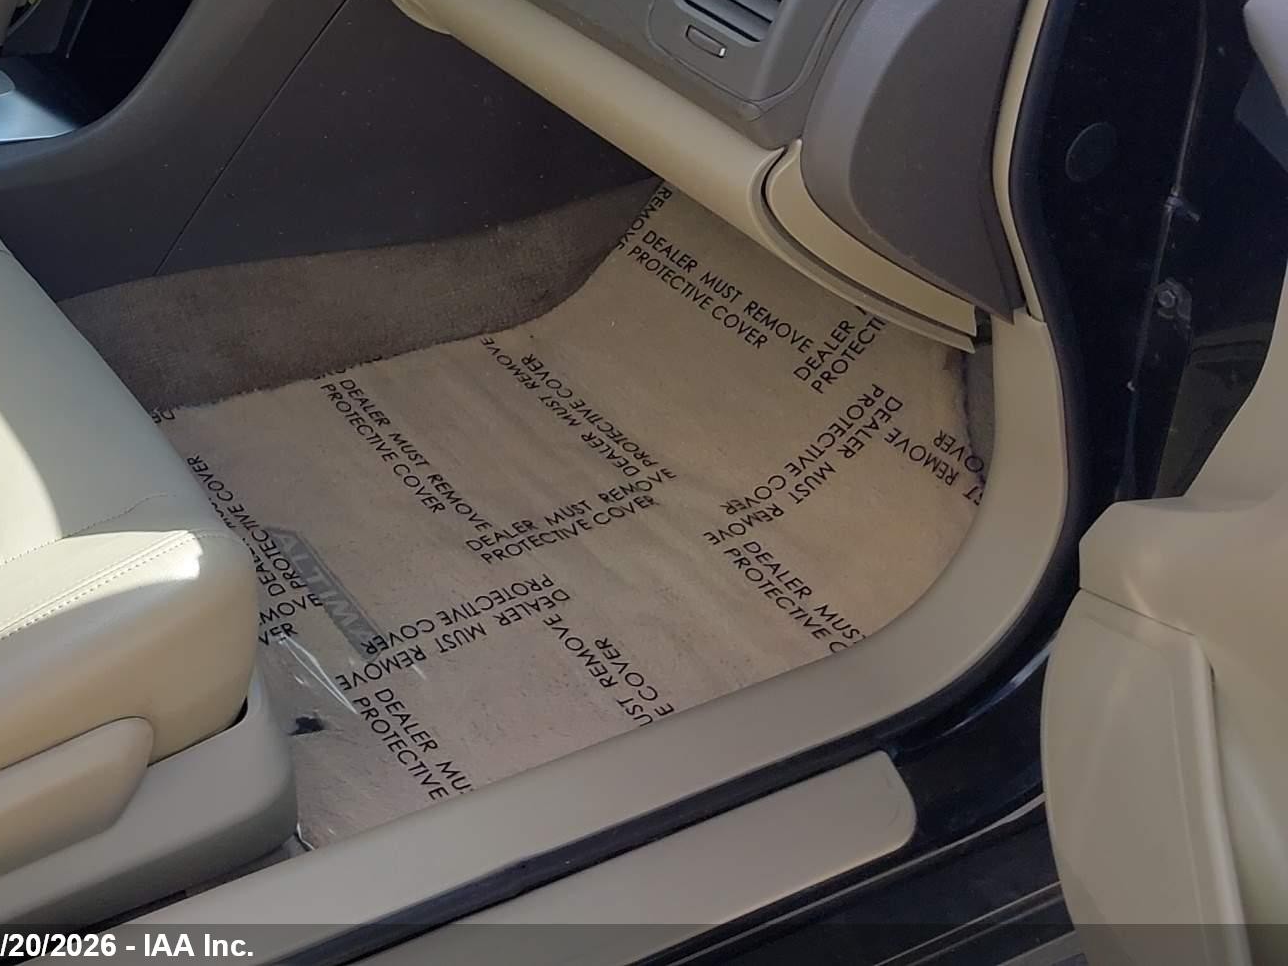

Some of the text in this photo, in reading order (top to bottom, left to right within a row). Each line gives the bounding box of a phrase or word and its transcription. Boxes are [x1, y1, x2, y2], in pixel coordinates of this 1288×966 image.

[627, 245, 768, 349] PROTECTIVE COVER
[642, 230, 813, 353] DEALER MUST REMOVE
[793, 320, 855, 381] DEALER
[320, 383, 399, 462] PROTECTIVE
[393, 464, 445, 513] COVER
[479, 336, 641, 477] DEALER MUST REMOVE
[521, 353, 659, 468] PROTECTIVE COVER
[719, 384, 885, 515] PROTECTIVE COVER
[186, 455, 234, 501] COVER
[339, 379, 390, 427] DEALER
[389, 432, 430, 467] MUST
[427, 473, 492, 531] REMOVE
[703, 396, 903, 545] DEALER MUST REMOVE
[884, 427, 960, 486] REMOVE
[933, 429, 986, 483] OVER
[226, 505, 301, 590] PROTECTIVE
[465, 467, 677, 552] DEALER MUST REMOVE
[481, 495, 659, 564] PROTECTIVE COVER
[258, 593, 324, 626] MOVE
[360, 573, 555, 656] PROTECTIVE COVER
[723, 547, 832, 640] PROTECTIVE
[743, 540, 812, 600] DEALER
[335, 588, 571, 691] DEALER MUST REMOVE
[543, 613, 618, 688] REMOVE
[594, 637, 658, 702] COVER
[352, 696, 450, 801] PROTECTIVE
[375, 688, 474, 794] DEALER MU
